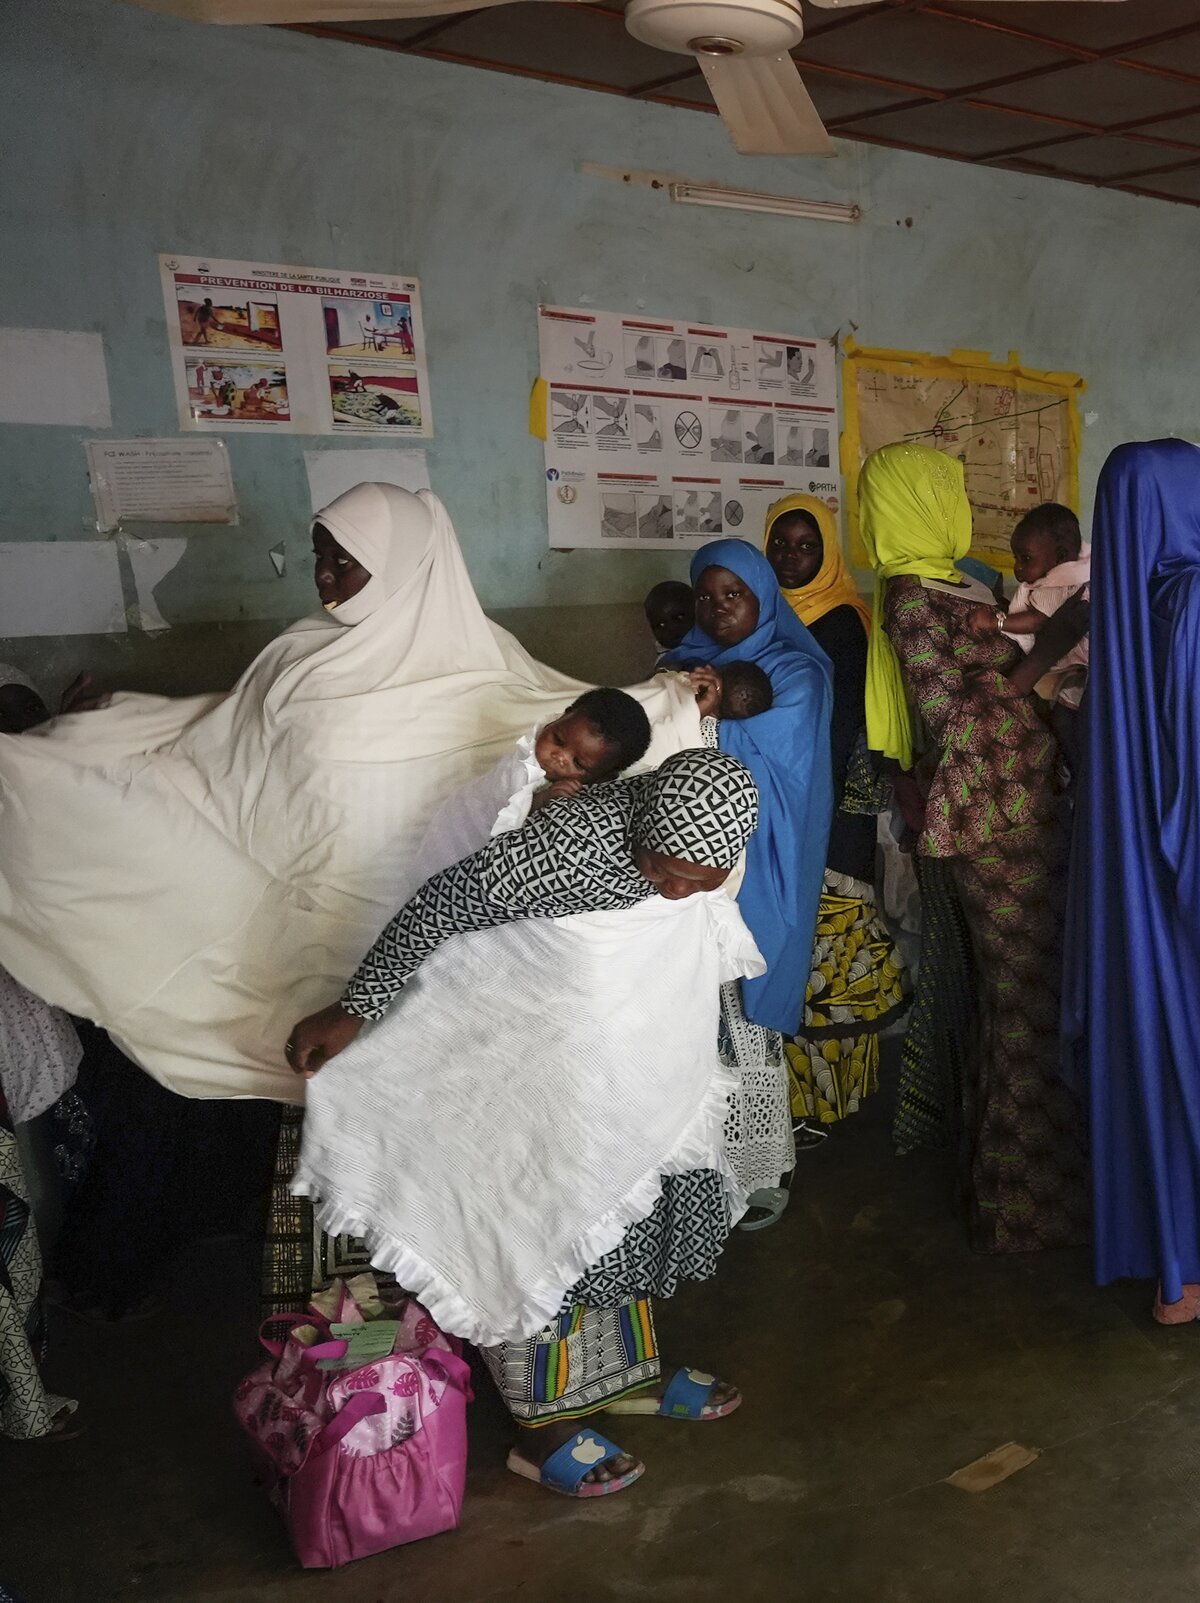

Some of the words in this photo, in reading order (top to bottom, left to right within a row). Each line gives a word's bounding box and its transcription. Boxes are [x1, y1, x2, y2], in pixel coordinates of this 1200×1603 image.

[200, 276, 277, 290] PREVENTION
[280, 284, 295, 292] DE
[298, 285, 313, 293] LA
[316, 286, 390, 300] BILHARZIOSE
[816, 482, 837, 492] PATH
